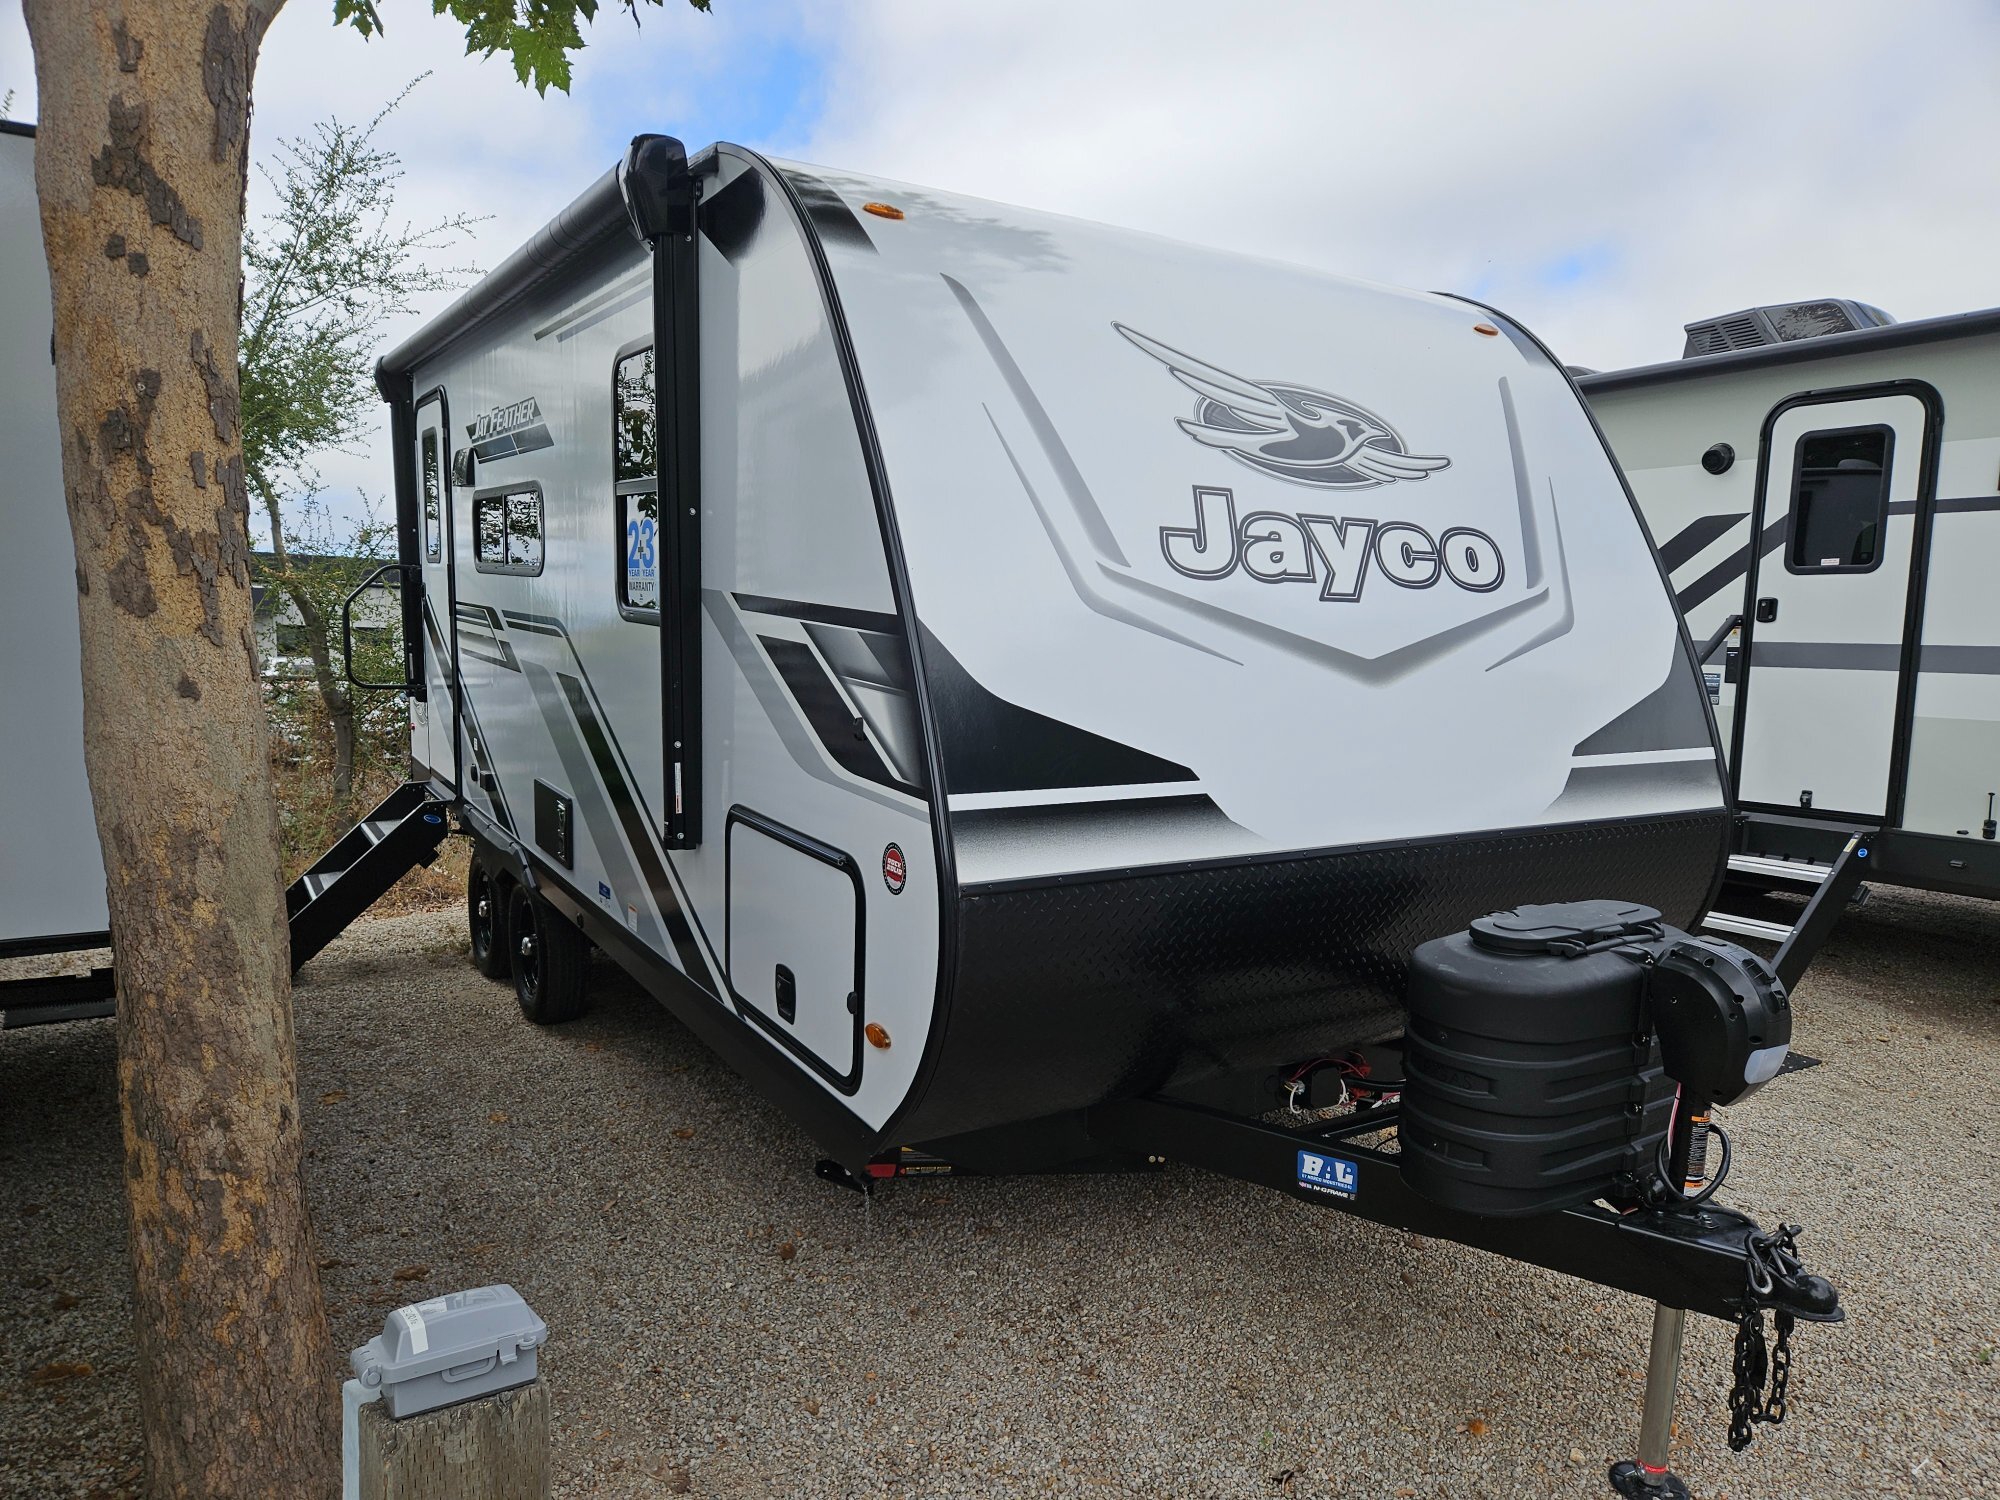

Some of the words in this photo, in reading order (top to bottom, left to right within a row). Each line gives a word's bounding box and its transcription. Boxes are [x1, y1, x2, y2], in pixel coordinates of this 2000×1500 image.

[471, 414, 490, 440] JAY
[489, 397, 535, 433] FEATHER
[1159, 484, 1505, 603] Jayco
[628, 569, 640, 577] YEAR
[642, 569, 655, 577] YEAR
[628, 581, 655, 592] WARRANTY
[1302, 1154, 1354, 1184] BAL
